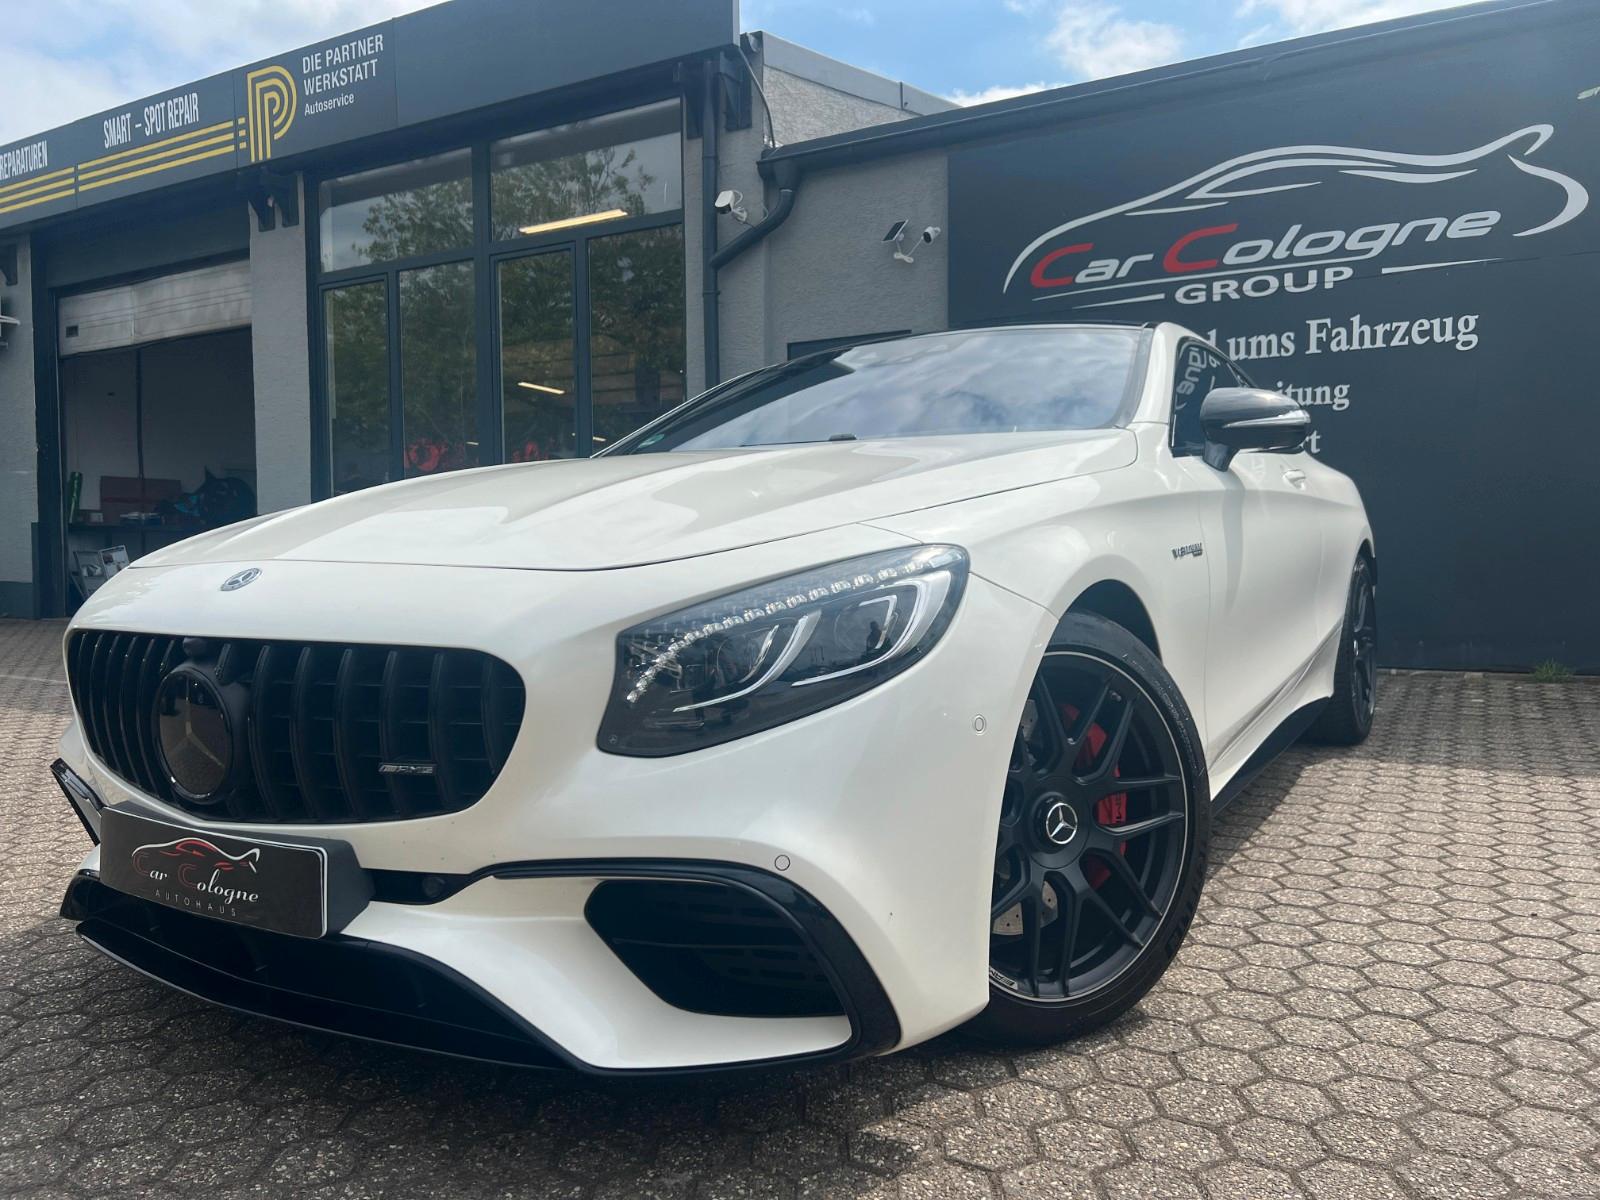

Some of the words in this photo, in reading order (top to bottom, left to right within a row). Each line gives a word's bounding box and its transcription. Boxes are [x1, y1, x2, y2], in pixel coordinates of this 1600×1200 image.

[302, 53, 322, 74] DIE
[325, 34, 384, 68] PARTNER
[303, 59, 378, 96] WERKSTATT
[103, 112, 132, 149] SMART
[143, 101, 166, 136] SPOT
[167, 92, 200, 130] REPAIR
[304, 92, 355, 117] Autoservice
[1030, 242, 1154, 288] Car
[1162, 210, 1502, 273] Cologne
[1174, 266, 1354, 305] GROUP
[1226, 330, 1296, 361] ums
[1305, 313, 1480, 356] Fahrzeug
[132, 850, 168, 881] Car
[177, 862, 260, 906] Cologne
[154, 889, 237, 918] AUTOHAUS
